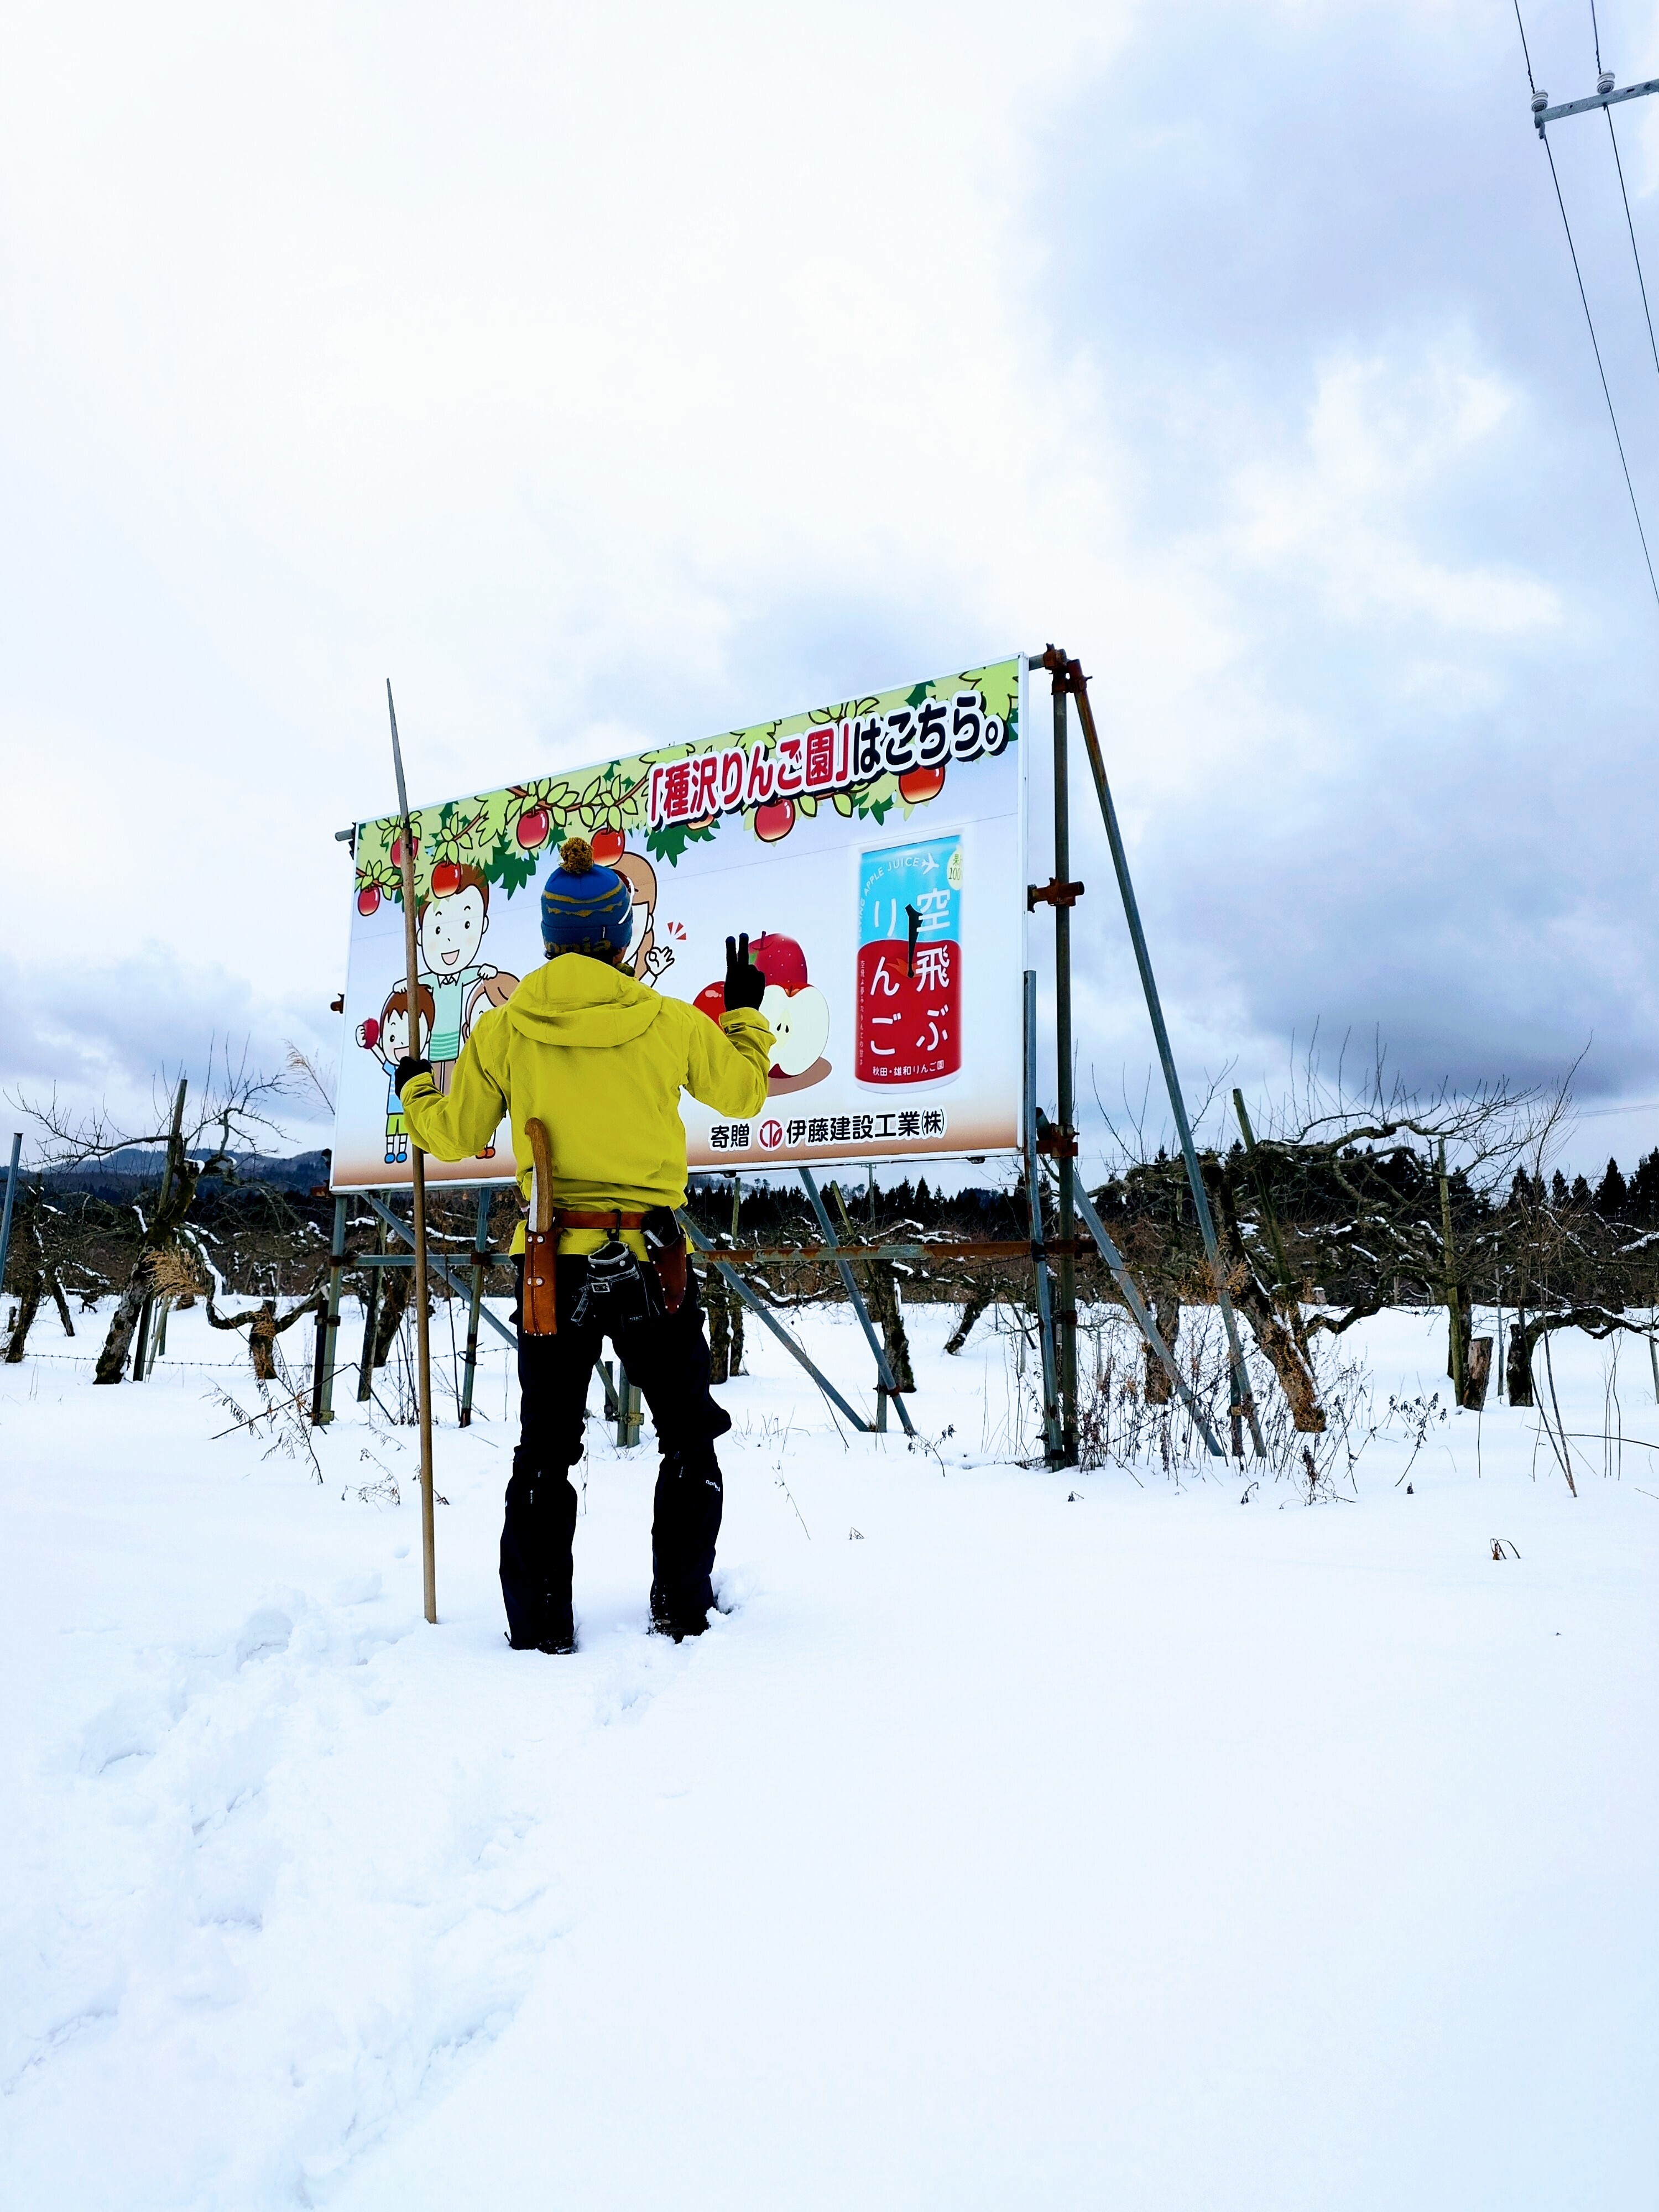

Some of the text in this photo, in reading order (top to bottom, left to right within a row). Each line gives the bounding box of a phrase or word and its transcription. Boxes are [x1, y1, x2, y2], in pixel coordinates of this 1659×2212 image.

[650, 695, 999, 822] 「種沢りんご園」はこちら。
[864, 867, 884, 896] APPLE
[888, 857, 920, 871] JUICE
[870, 898, 902, 1055] りんご
[915, 888, 951, 1051] 空飛ぶ
[711, 1124, 750, 1148] 寄贈
